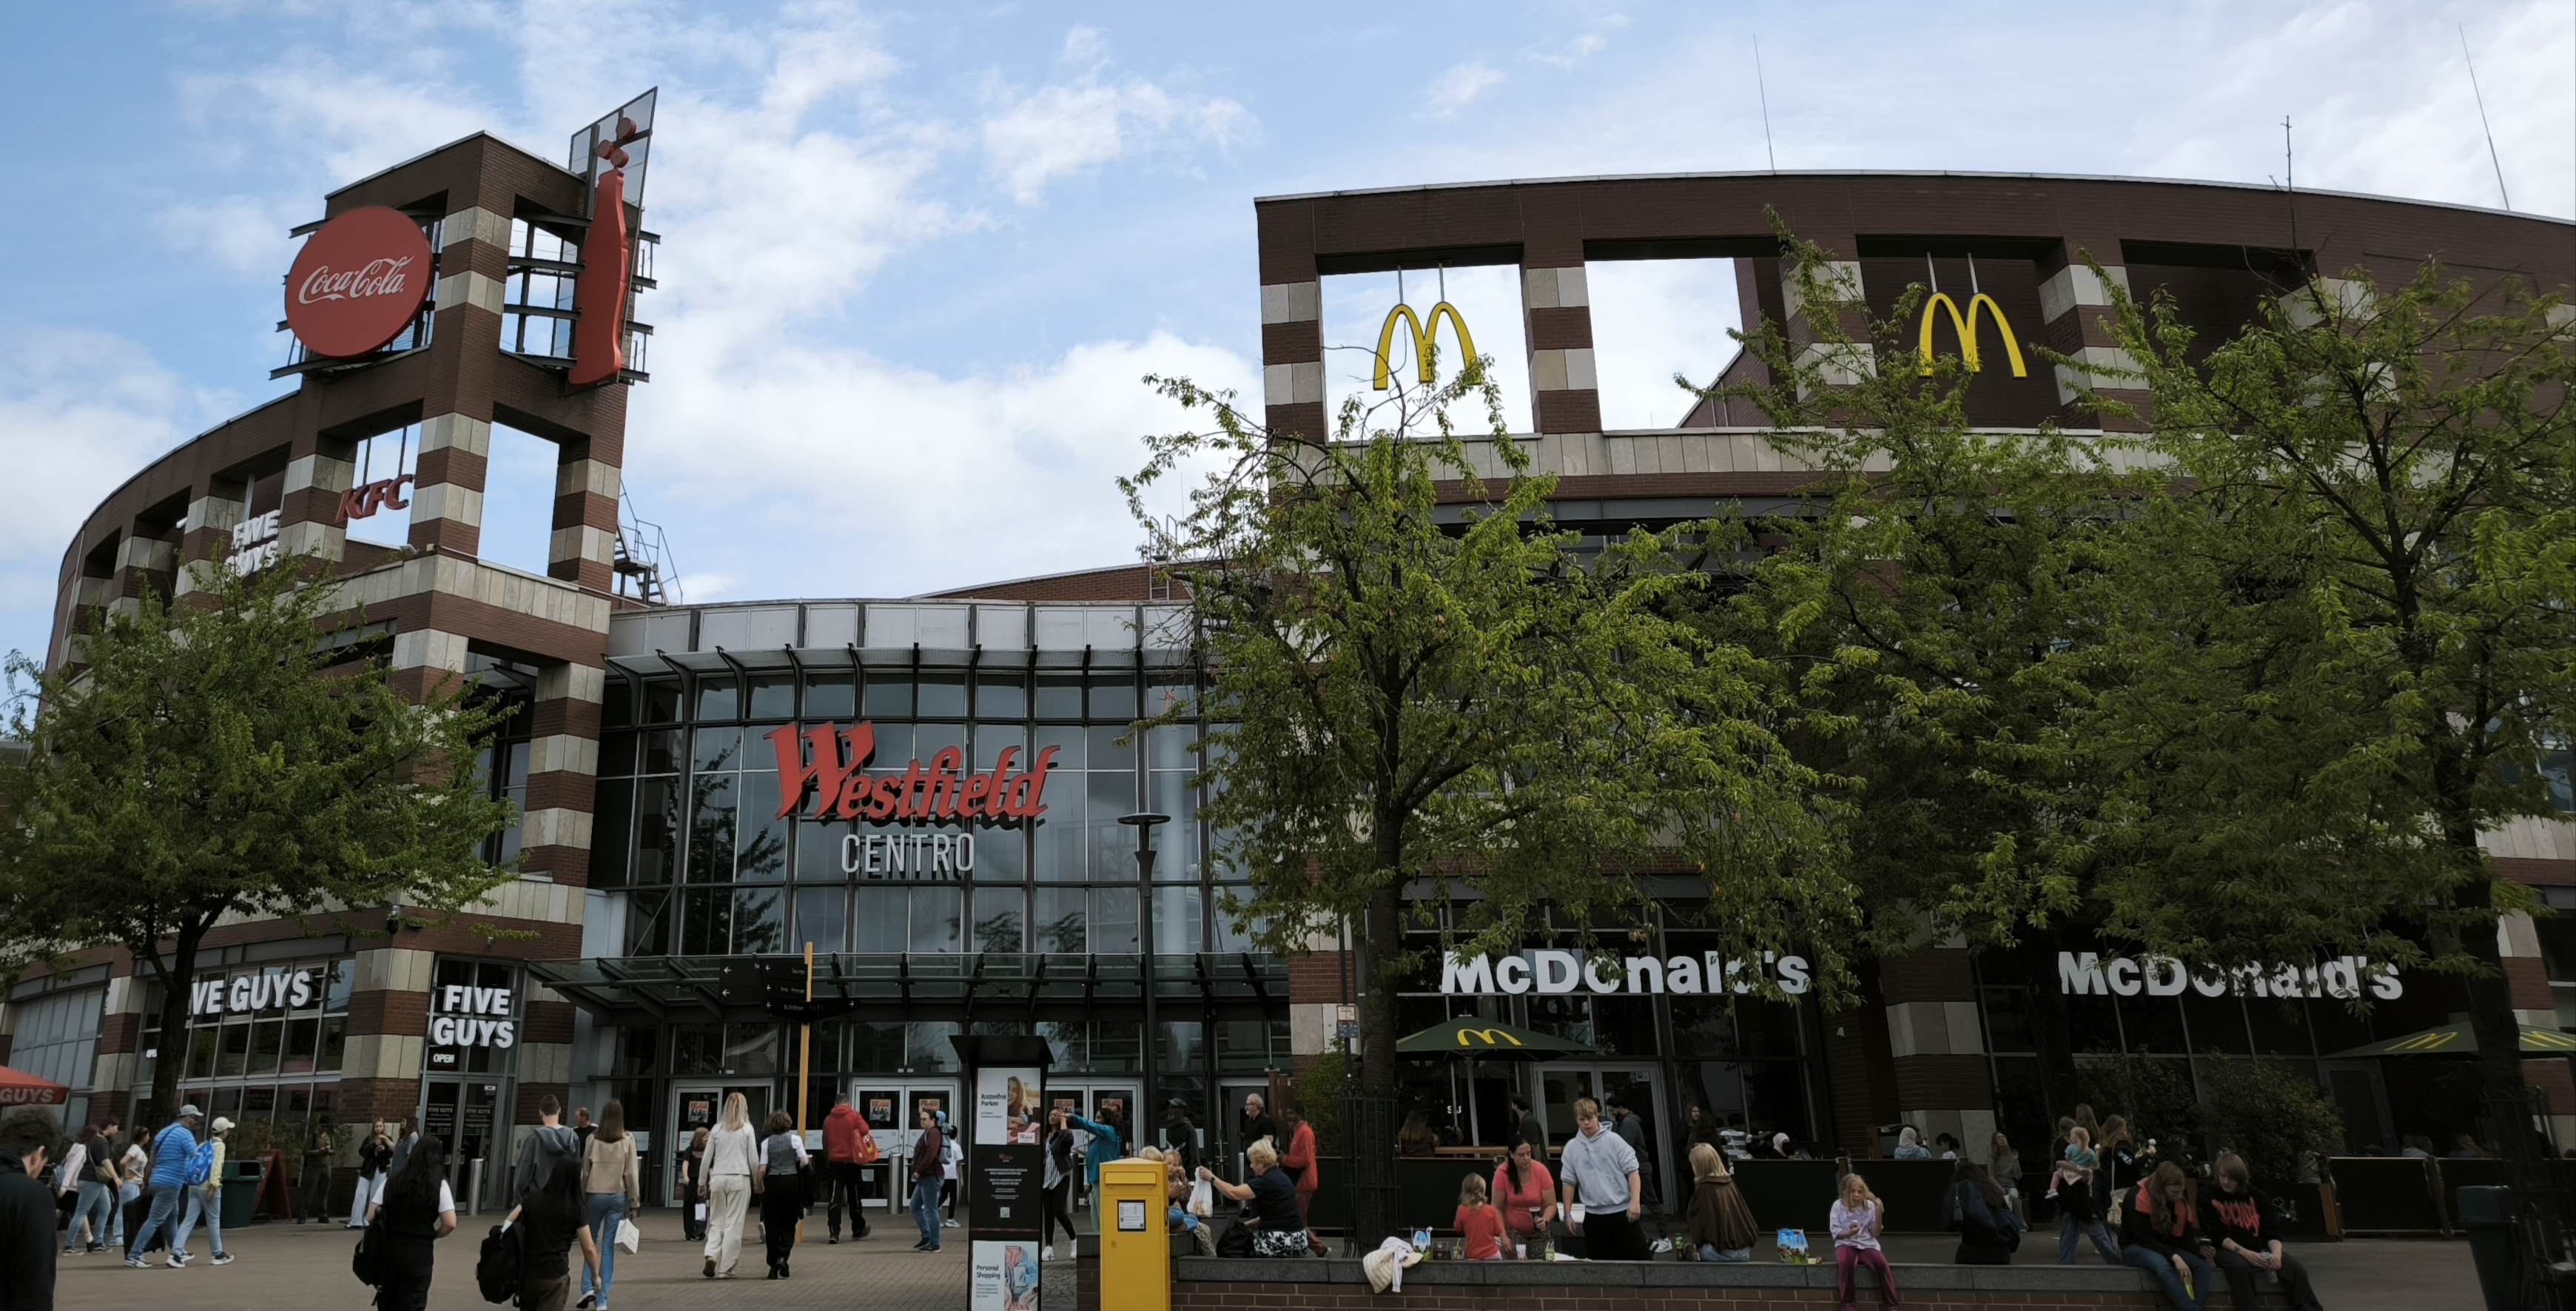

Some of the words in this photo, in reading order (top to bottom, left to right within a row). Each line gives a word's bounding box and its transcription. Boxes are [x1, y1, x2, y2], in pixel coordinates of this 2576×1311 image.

[334, 473, 415, 523] KFC
[231, 509, 281, 550] FIVE
[763, 720, 1061, 821] Westfield
[841, 833, 975, 874] CENTRO
[192, 979, 224, 1015] VE
[230, 971, 313, 1012] GUYS
[443, 985, 511, 1015] FIVE
[433, 1017, 514, 1048] GUYS
[432, 1053, 455, 1063] OPEN
[0, 1087, 54, 1103] GUYS
